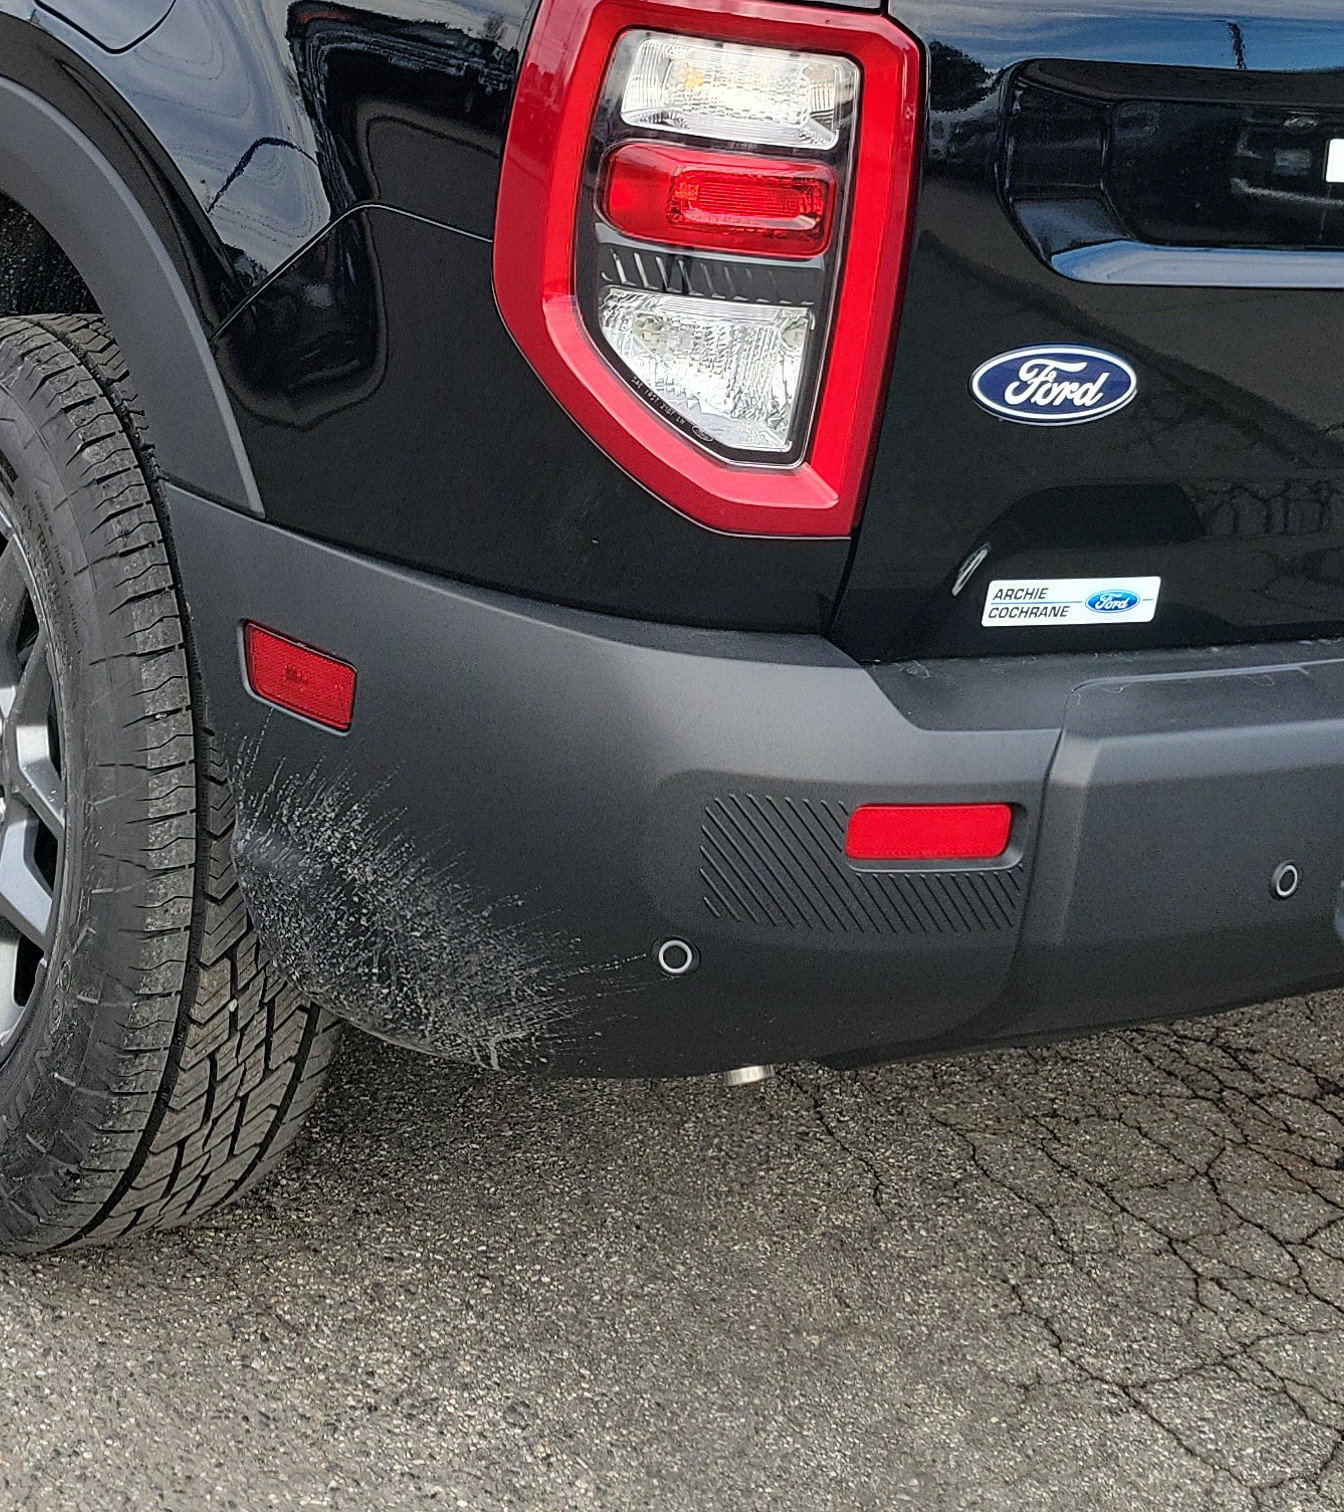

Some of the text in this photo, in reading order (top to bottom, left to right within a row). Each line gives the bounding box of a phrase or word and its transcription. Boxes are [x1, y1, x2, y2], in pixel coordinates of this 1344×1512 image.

[1004, 358, 1110, 407] Ford
[992, 587, 1049, 601] ARCHIE
[1094, 591, 1130, 610] Ford
[988, 605, 1070, 619] COCHRANE
